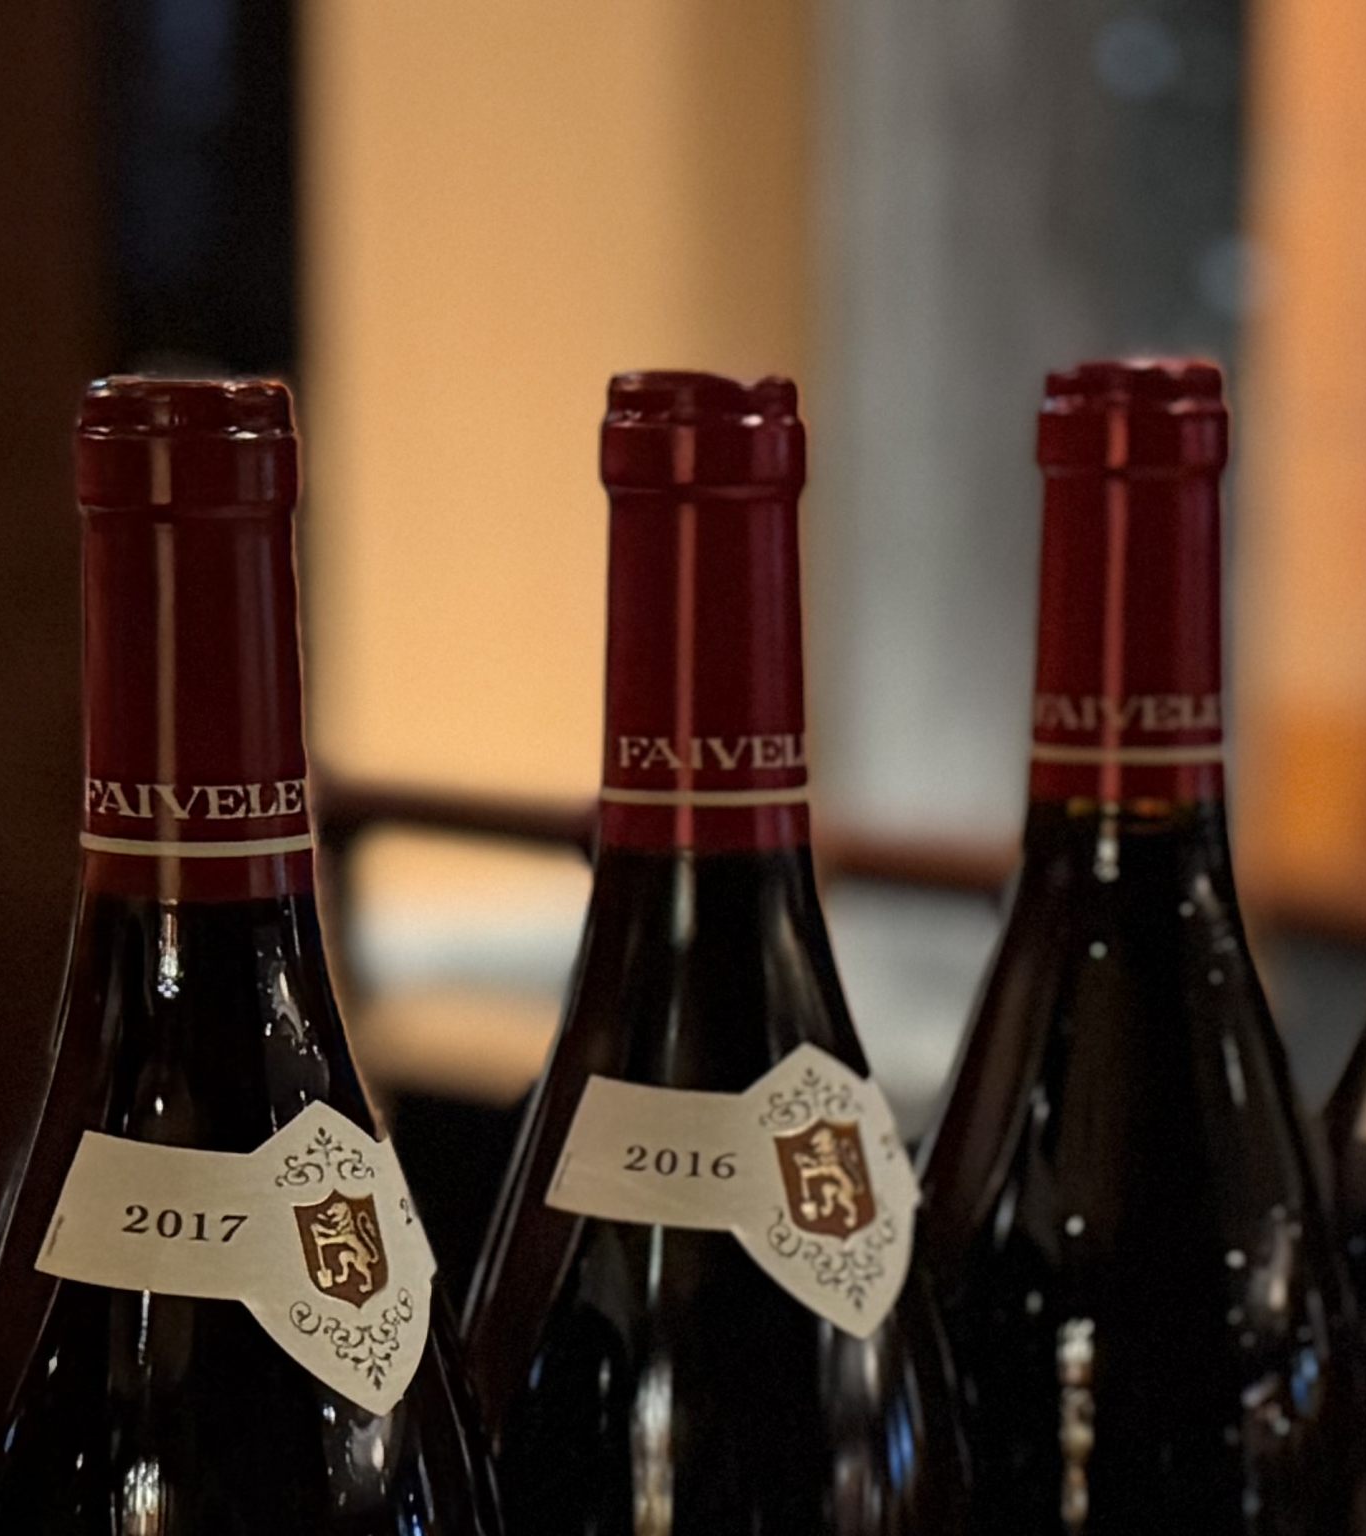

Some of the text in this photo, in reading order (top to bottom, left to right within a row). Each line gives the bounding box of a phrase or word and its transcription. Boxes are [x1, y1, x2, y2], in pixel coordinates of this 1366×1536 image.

[86, 778, 307, 820] FAIVELE
[624, 1145, 739, 1180] 2016
[121, 1204, 249, 1243] 2017
